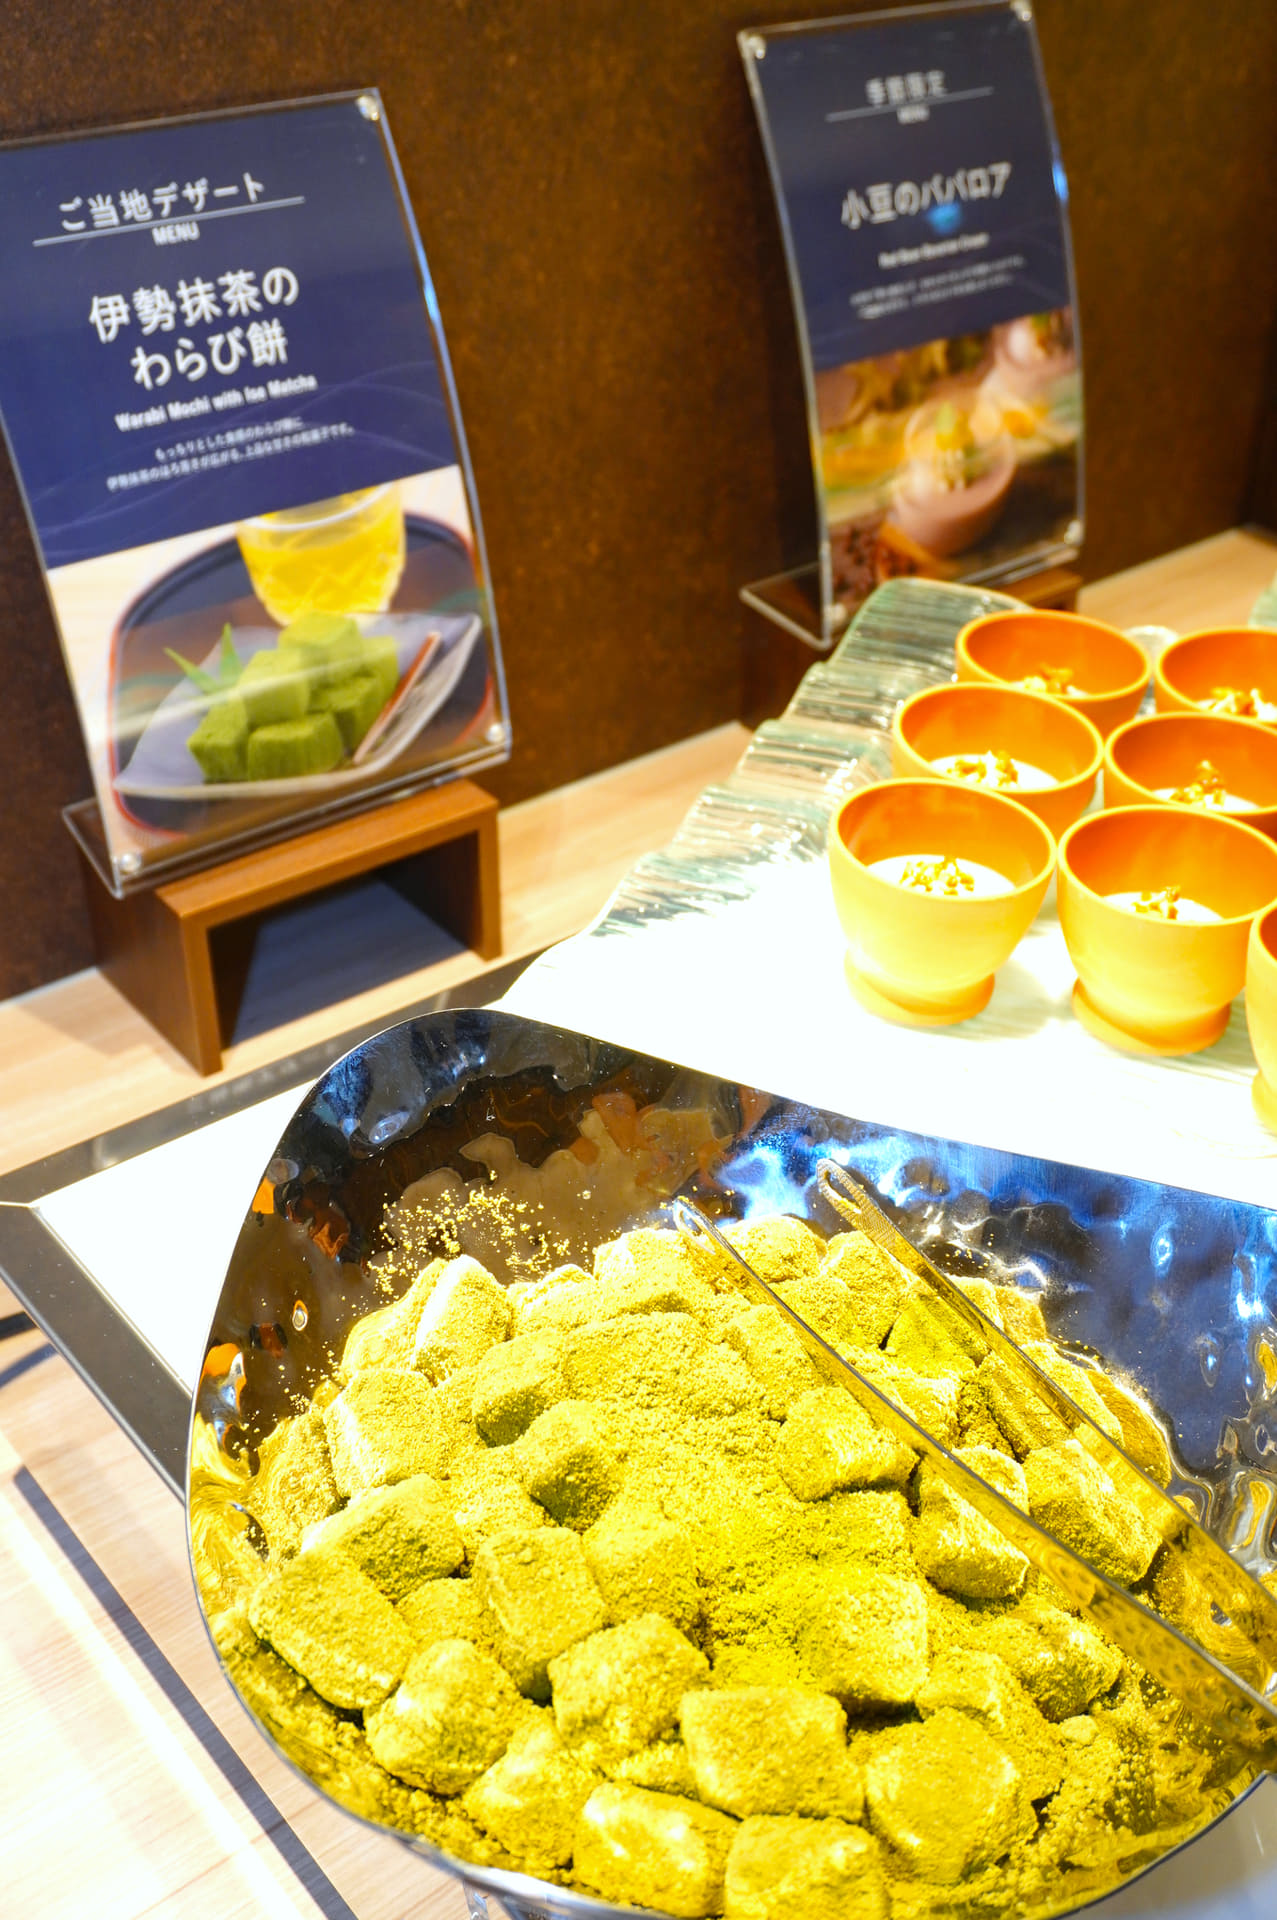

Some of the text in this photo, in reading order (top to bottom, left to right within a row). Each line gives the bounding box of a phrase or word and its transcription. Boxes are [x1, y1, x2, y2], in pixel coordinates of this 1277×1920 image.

[59, 172, 264, 231] ご当地デザート
[152, 222, 199, 246] MENU
[89, 266, 299, 343] 伊勢抹茶の
[130, 318, 288, 391] わらび餅
[114, 405, 168, 432] Warabi
[167, 395, 212, 421] Mochi
[211, 388, 244, 411] with
[267, 374, 319, 398] Matcha
